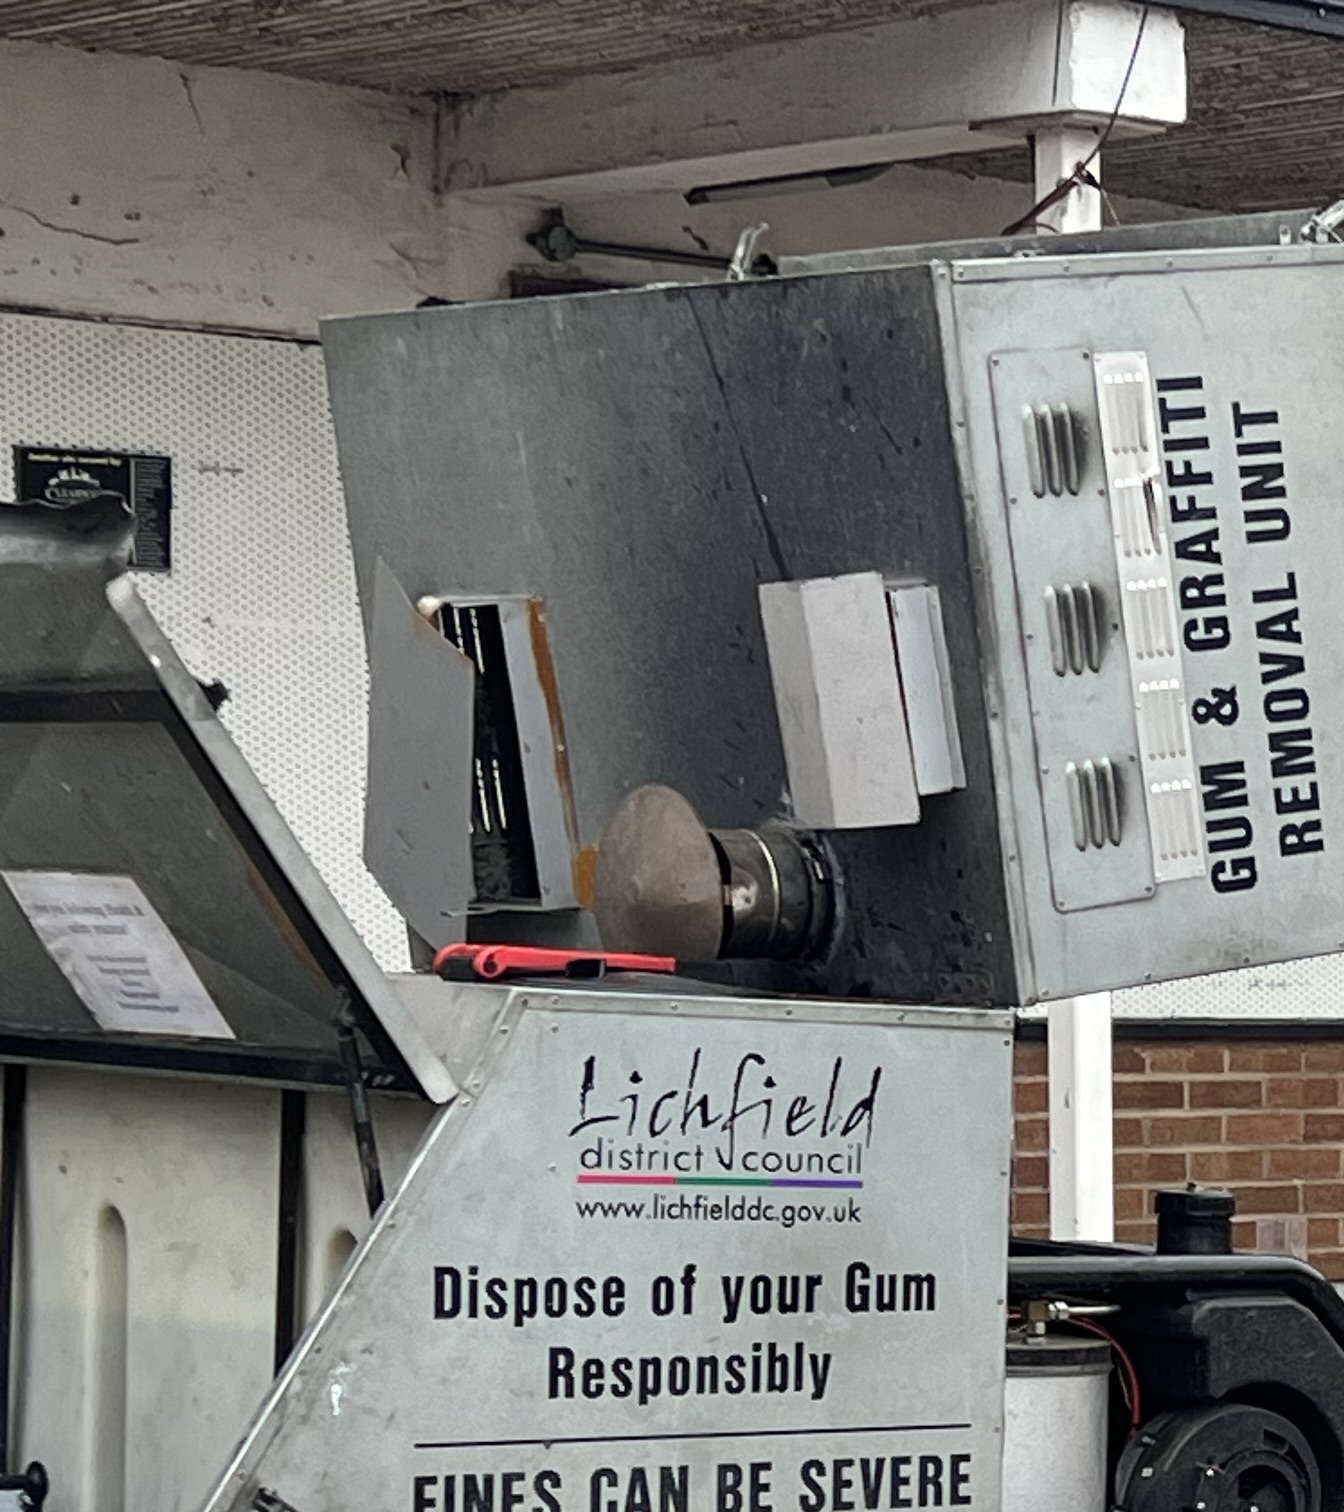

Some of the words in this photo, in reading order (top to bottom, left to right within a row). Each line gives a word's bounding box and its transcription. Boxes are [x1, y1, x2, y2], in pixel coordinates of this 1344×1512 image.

[1231, 402, 1292, 544] UNIT
[1156, 376, 1232, 652] GRAFFITI
[1191, 686, 1239, 726] &
[1251, 571, 1324, 857] REMOVAL
[1200, 760, 1258, 894] GUM
[568, 1047, 882, 1170] Lichfield
[580, 1137, 704, 1171] district
[741, 1143, 862, 1174] council
[576, 1193, 862, 1228] www.lichfielddc.gov.uk
[433, 1266, 626, 1327] Dispose
[651, 1264, 696, 1318] of
[722, 1271, 822, 1324] your
[845, 1262, 936, 1314] Gum
[548, 1342, 831, 1406] Responsibly
[799, 1453, 973, 1512] SEVERE
